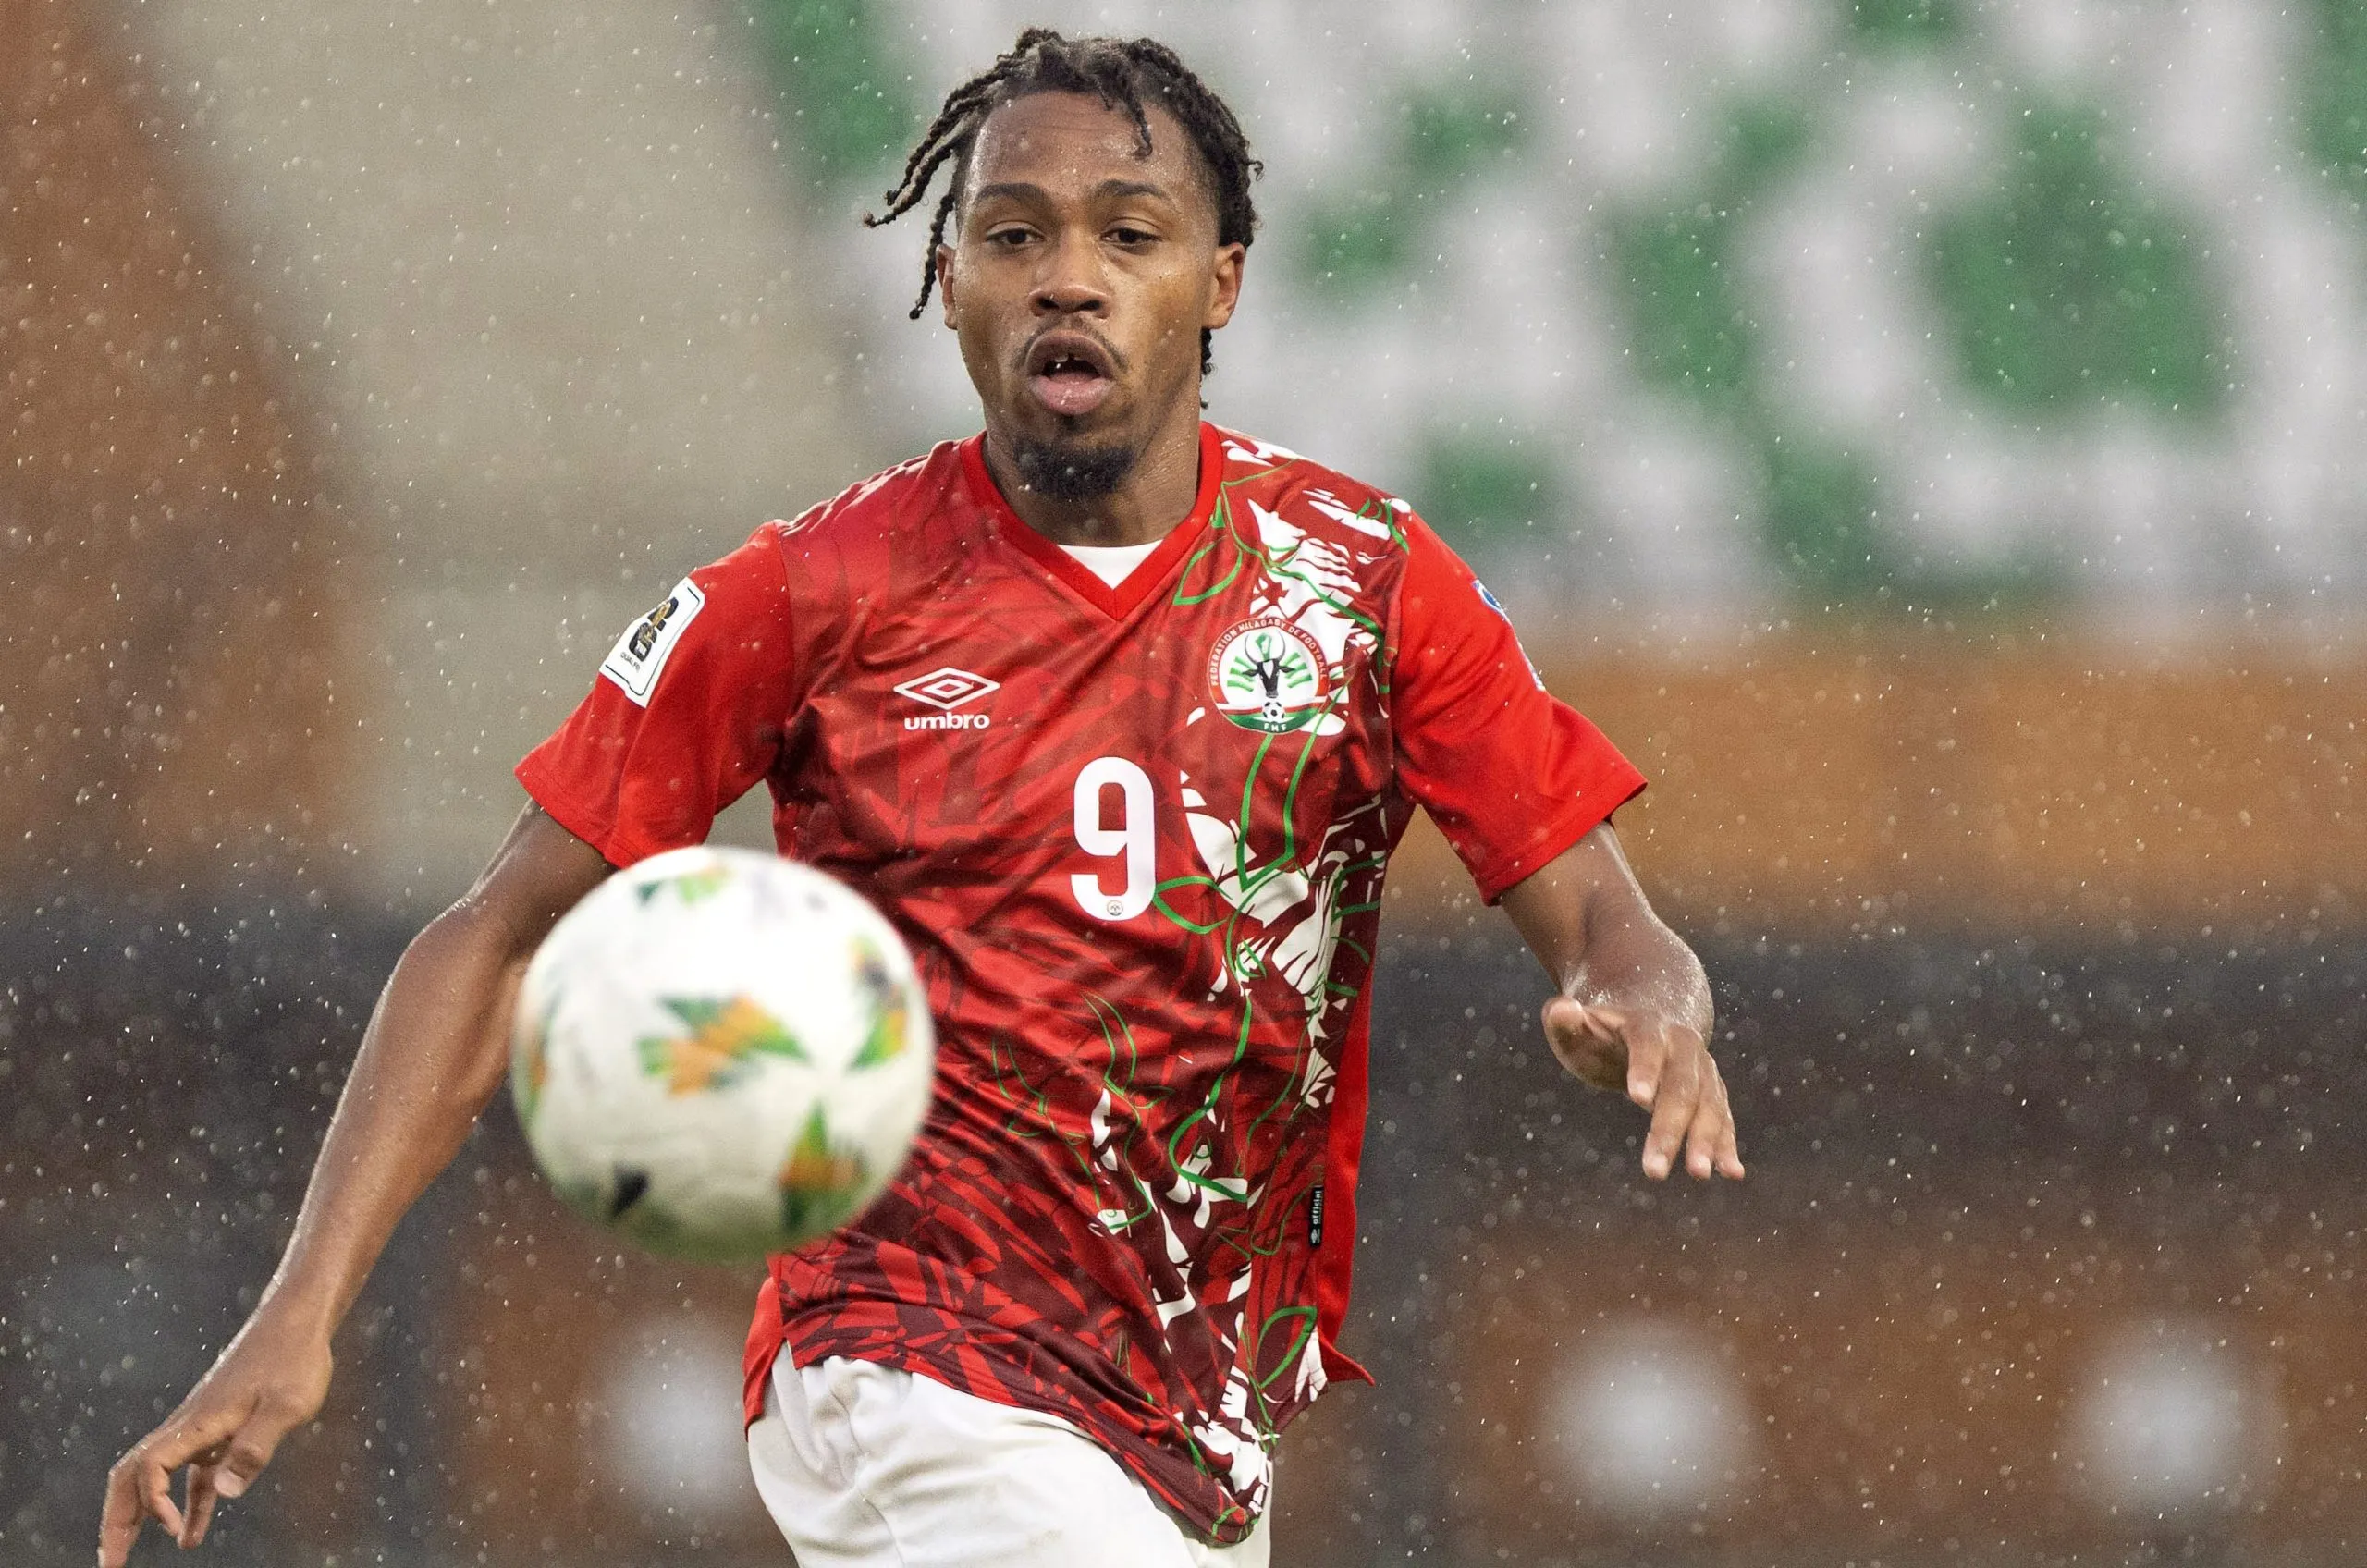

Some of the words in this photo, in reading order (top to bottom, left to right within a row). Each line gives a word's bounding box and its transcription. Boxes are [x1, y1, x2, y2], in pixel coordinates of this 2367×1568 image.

[1209, 627, 1238, 686] FEDERATION
[1288, 626, 1300, 636] DE
[1300, 632, 1328, 680] FOOTBALL
[904, 712, 990, 730] umbro
[1263, 722, 1286, 732] FMF
[1070, 756, 1157, 921] 9
[1311, 1190, 1322, 1225] official
